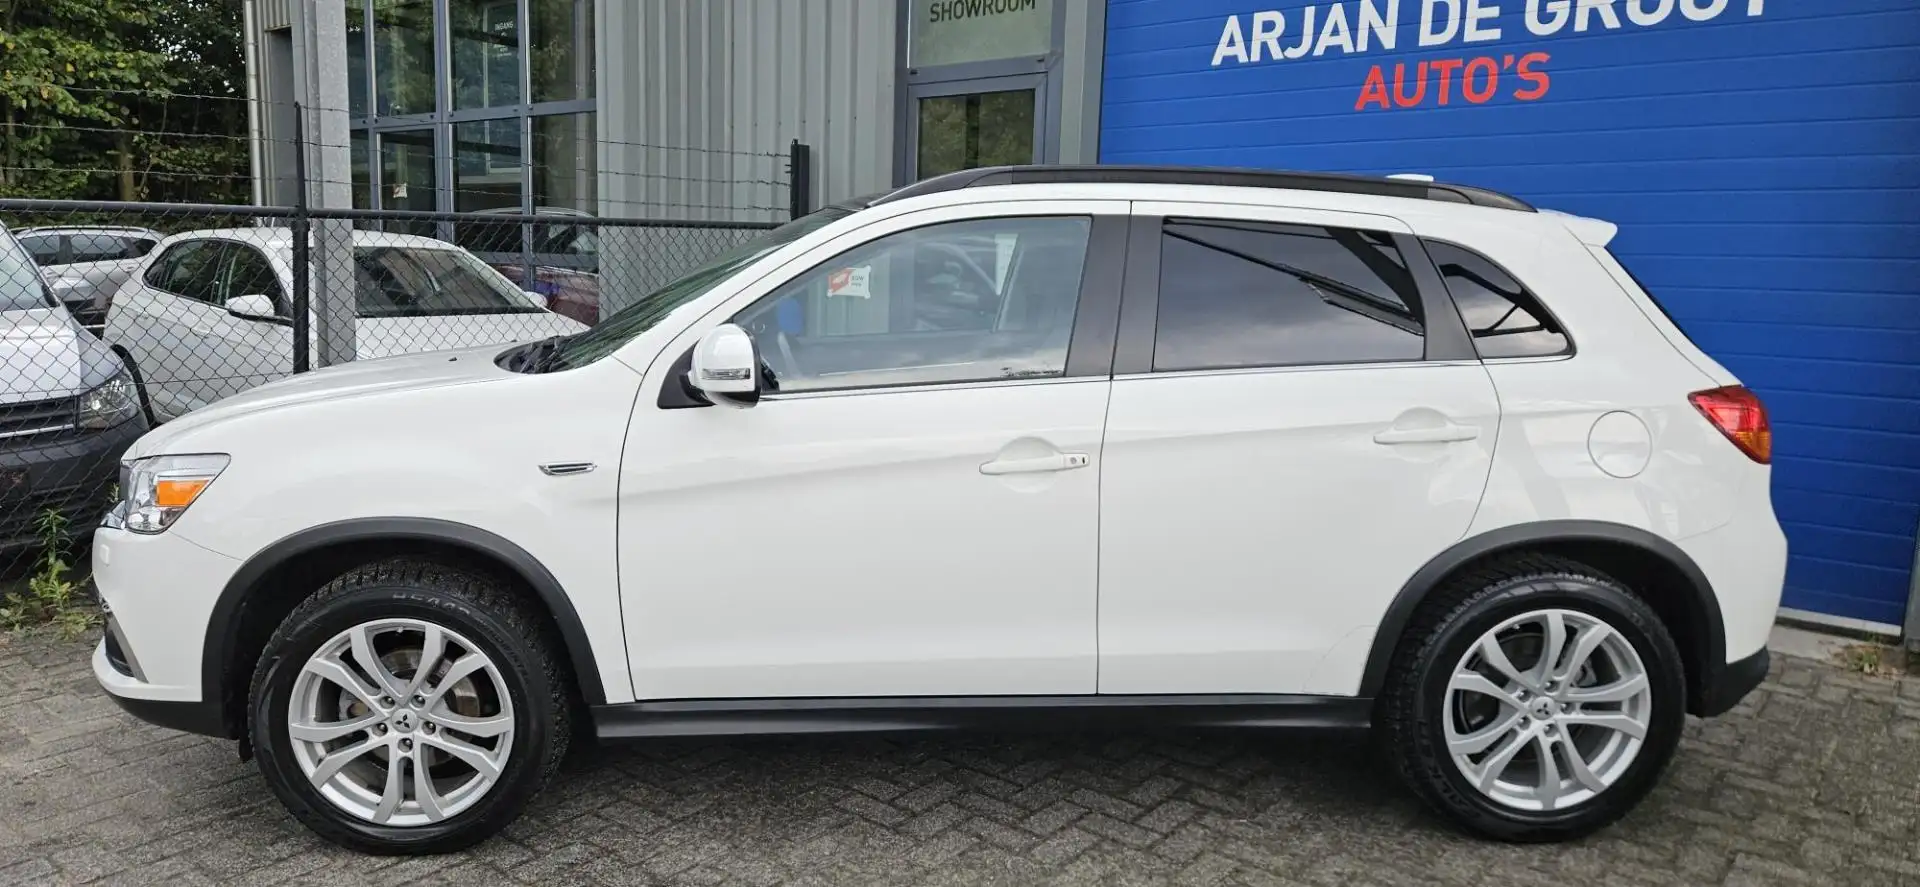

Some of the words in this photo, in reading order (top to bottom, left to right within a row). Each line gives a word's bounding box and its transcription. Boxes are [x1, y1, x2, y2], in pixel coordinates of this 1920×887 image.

[929, 0, 1036, 22] SHOWROOM
[1211, 0, 1400, 66] ARJAN
[1418, 0, 1502, 47] DE
[1354, 53, 1550, 110] AUTO'S
